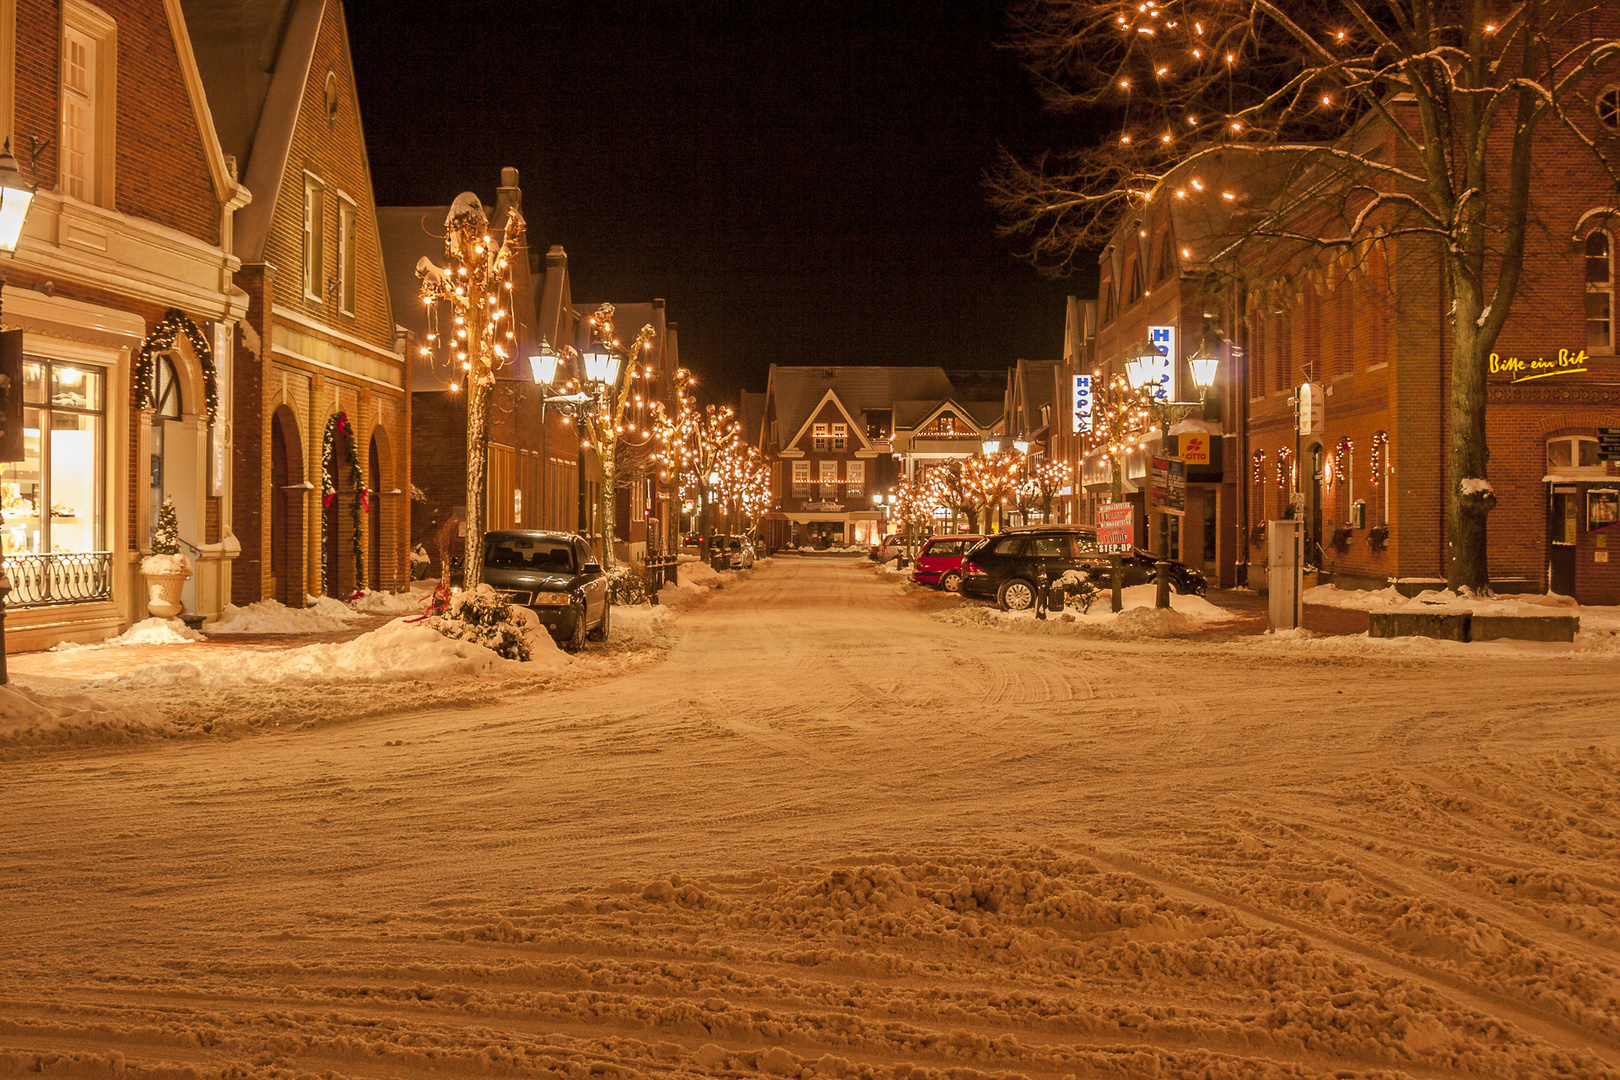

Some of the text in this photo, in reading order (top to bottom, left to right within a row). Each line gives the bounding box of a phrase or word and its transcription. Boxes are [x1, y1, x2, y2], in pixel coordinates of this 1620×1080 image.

[1489, 348, 1590, 374] Bitte ein Bit
[1098, 543, 1132, 553] STEP-UP
